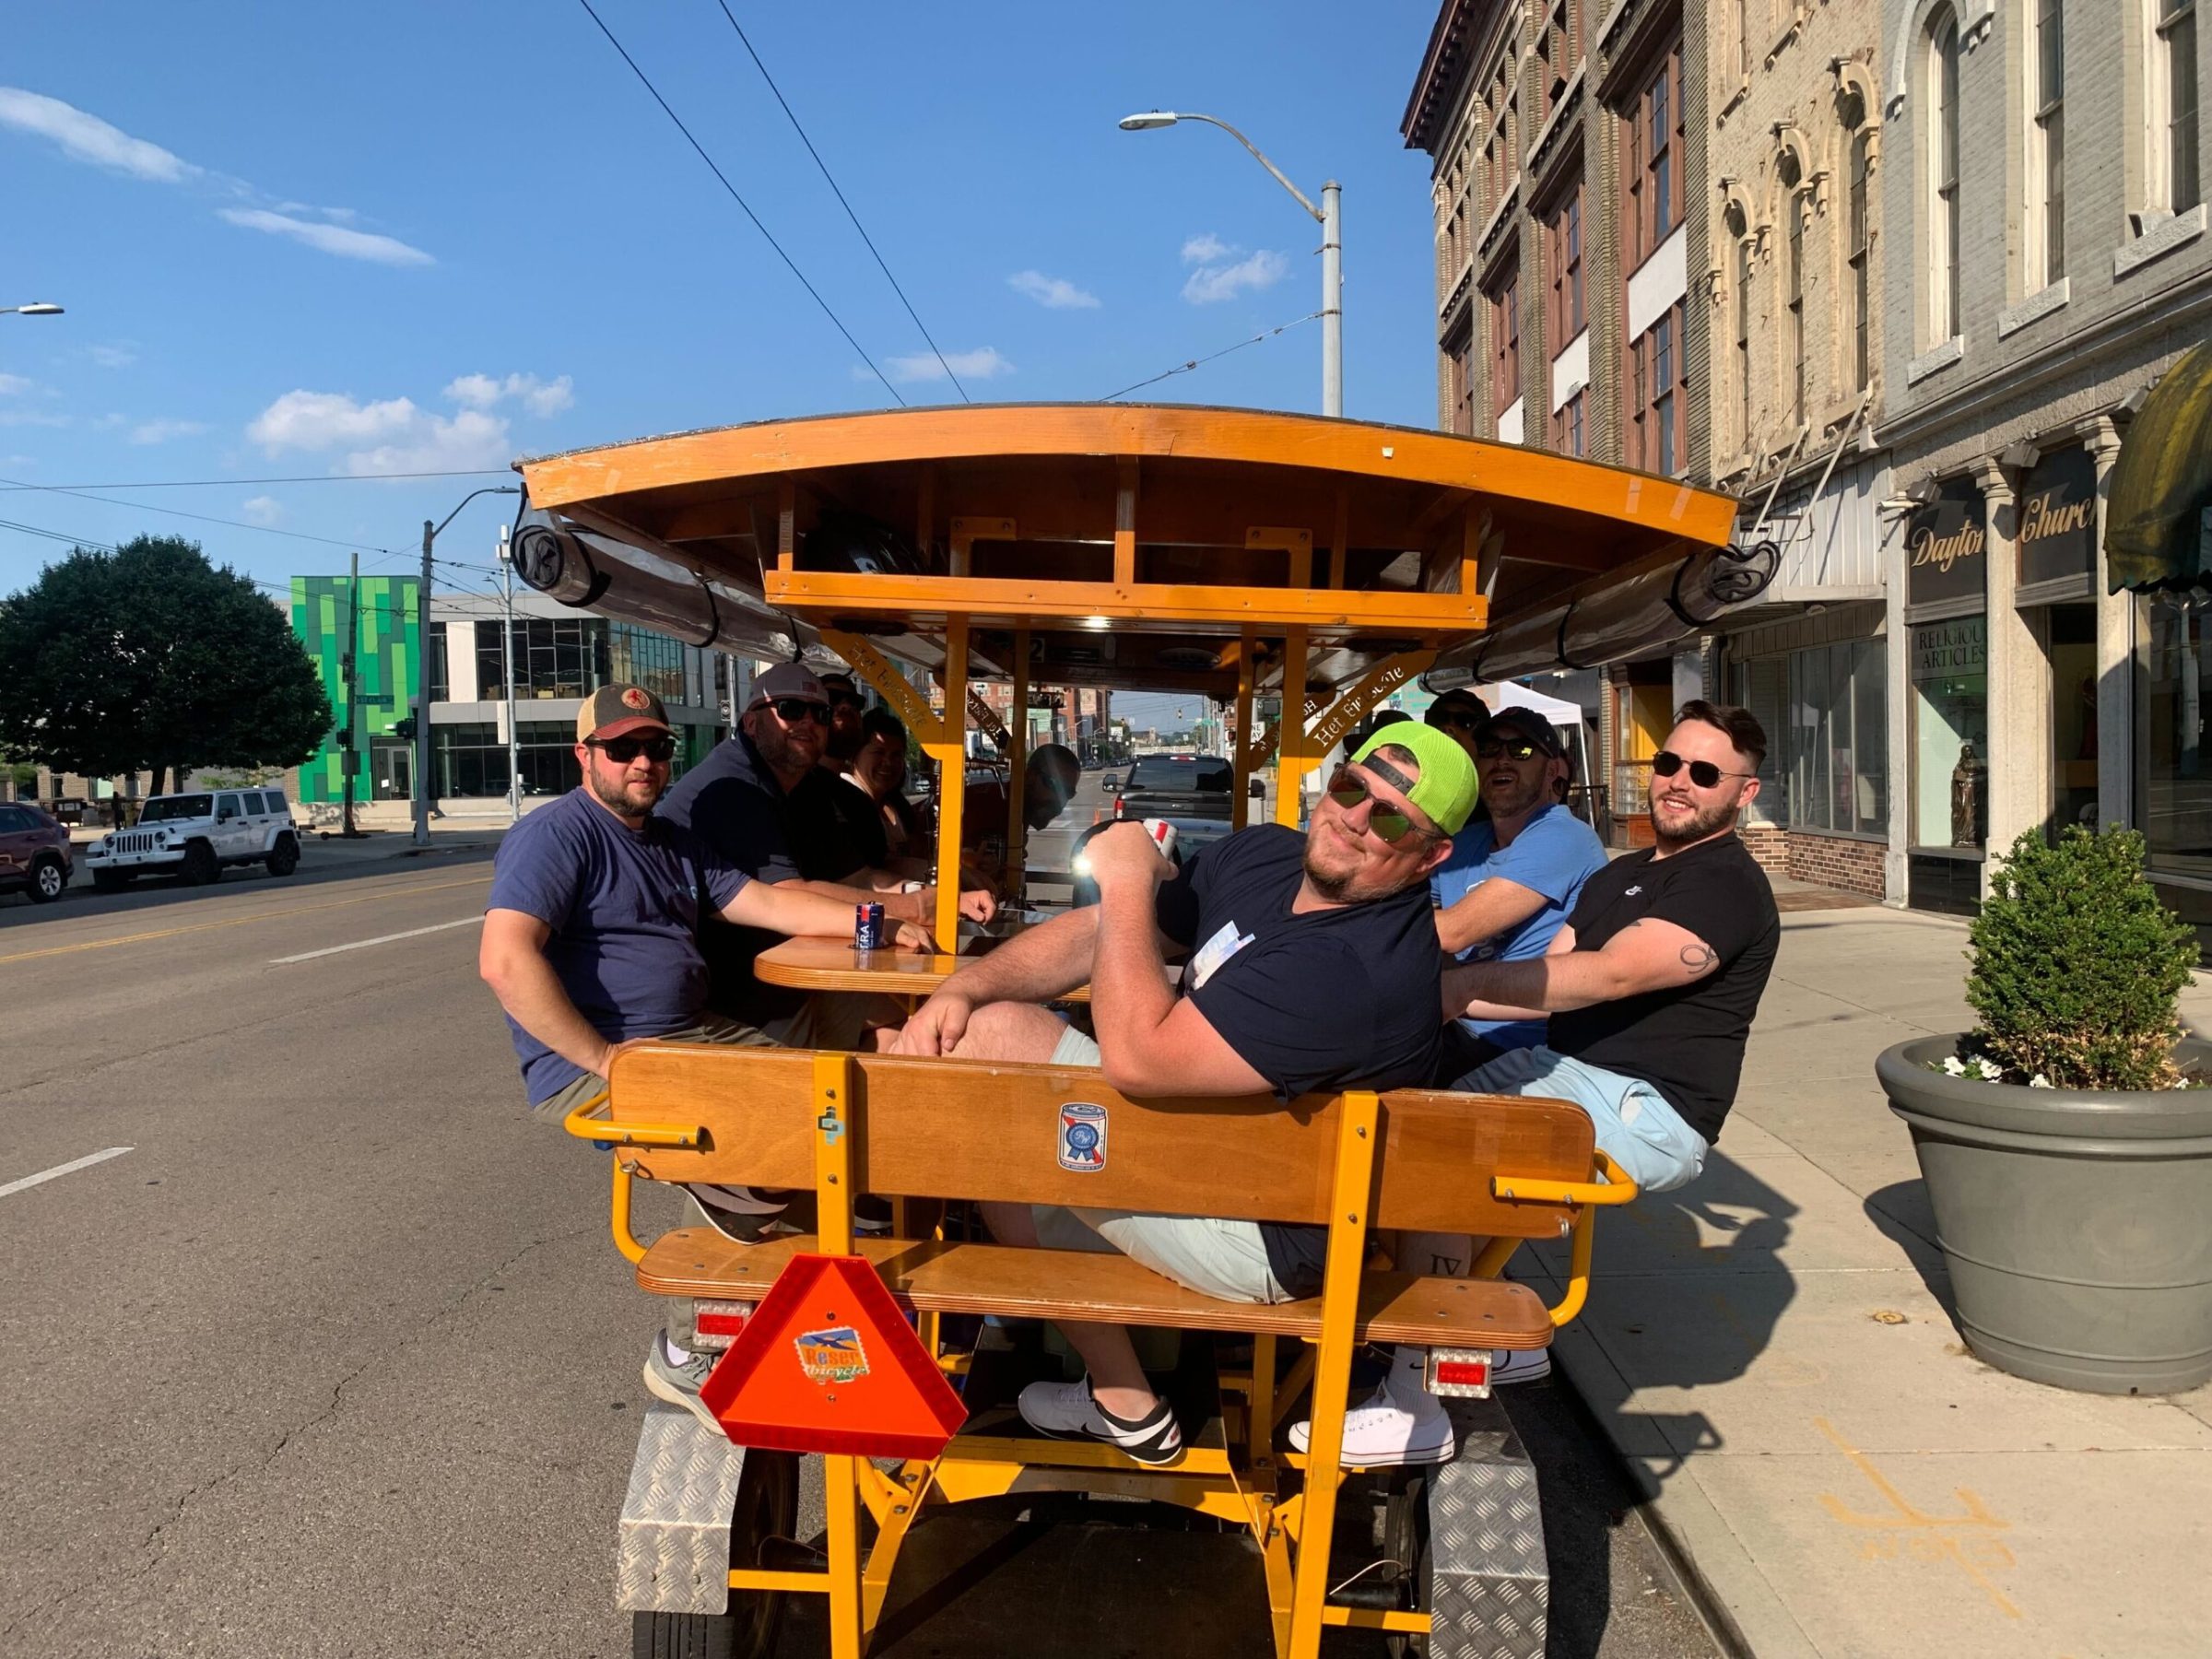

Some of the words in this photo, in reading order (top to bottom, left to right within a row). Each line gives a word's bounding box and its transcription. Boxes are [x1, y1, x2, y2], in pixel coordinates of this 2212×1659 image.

[1919, 625, 1983, 650] RELIGIOU
[1922, 646, 1985, 669] ARTICLES
[1313, 716, 1346, 747] Het
[860, 924, 869, 948] TRA
[805, 1348, 858, 1365] Reser
